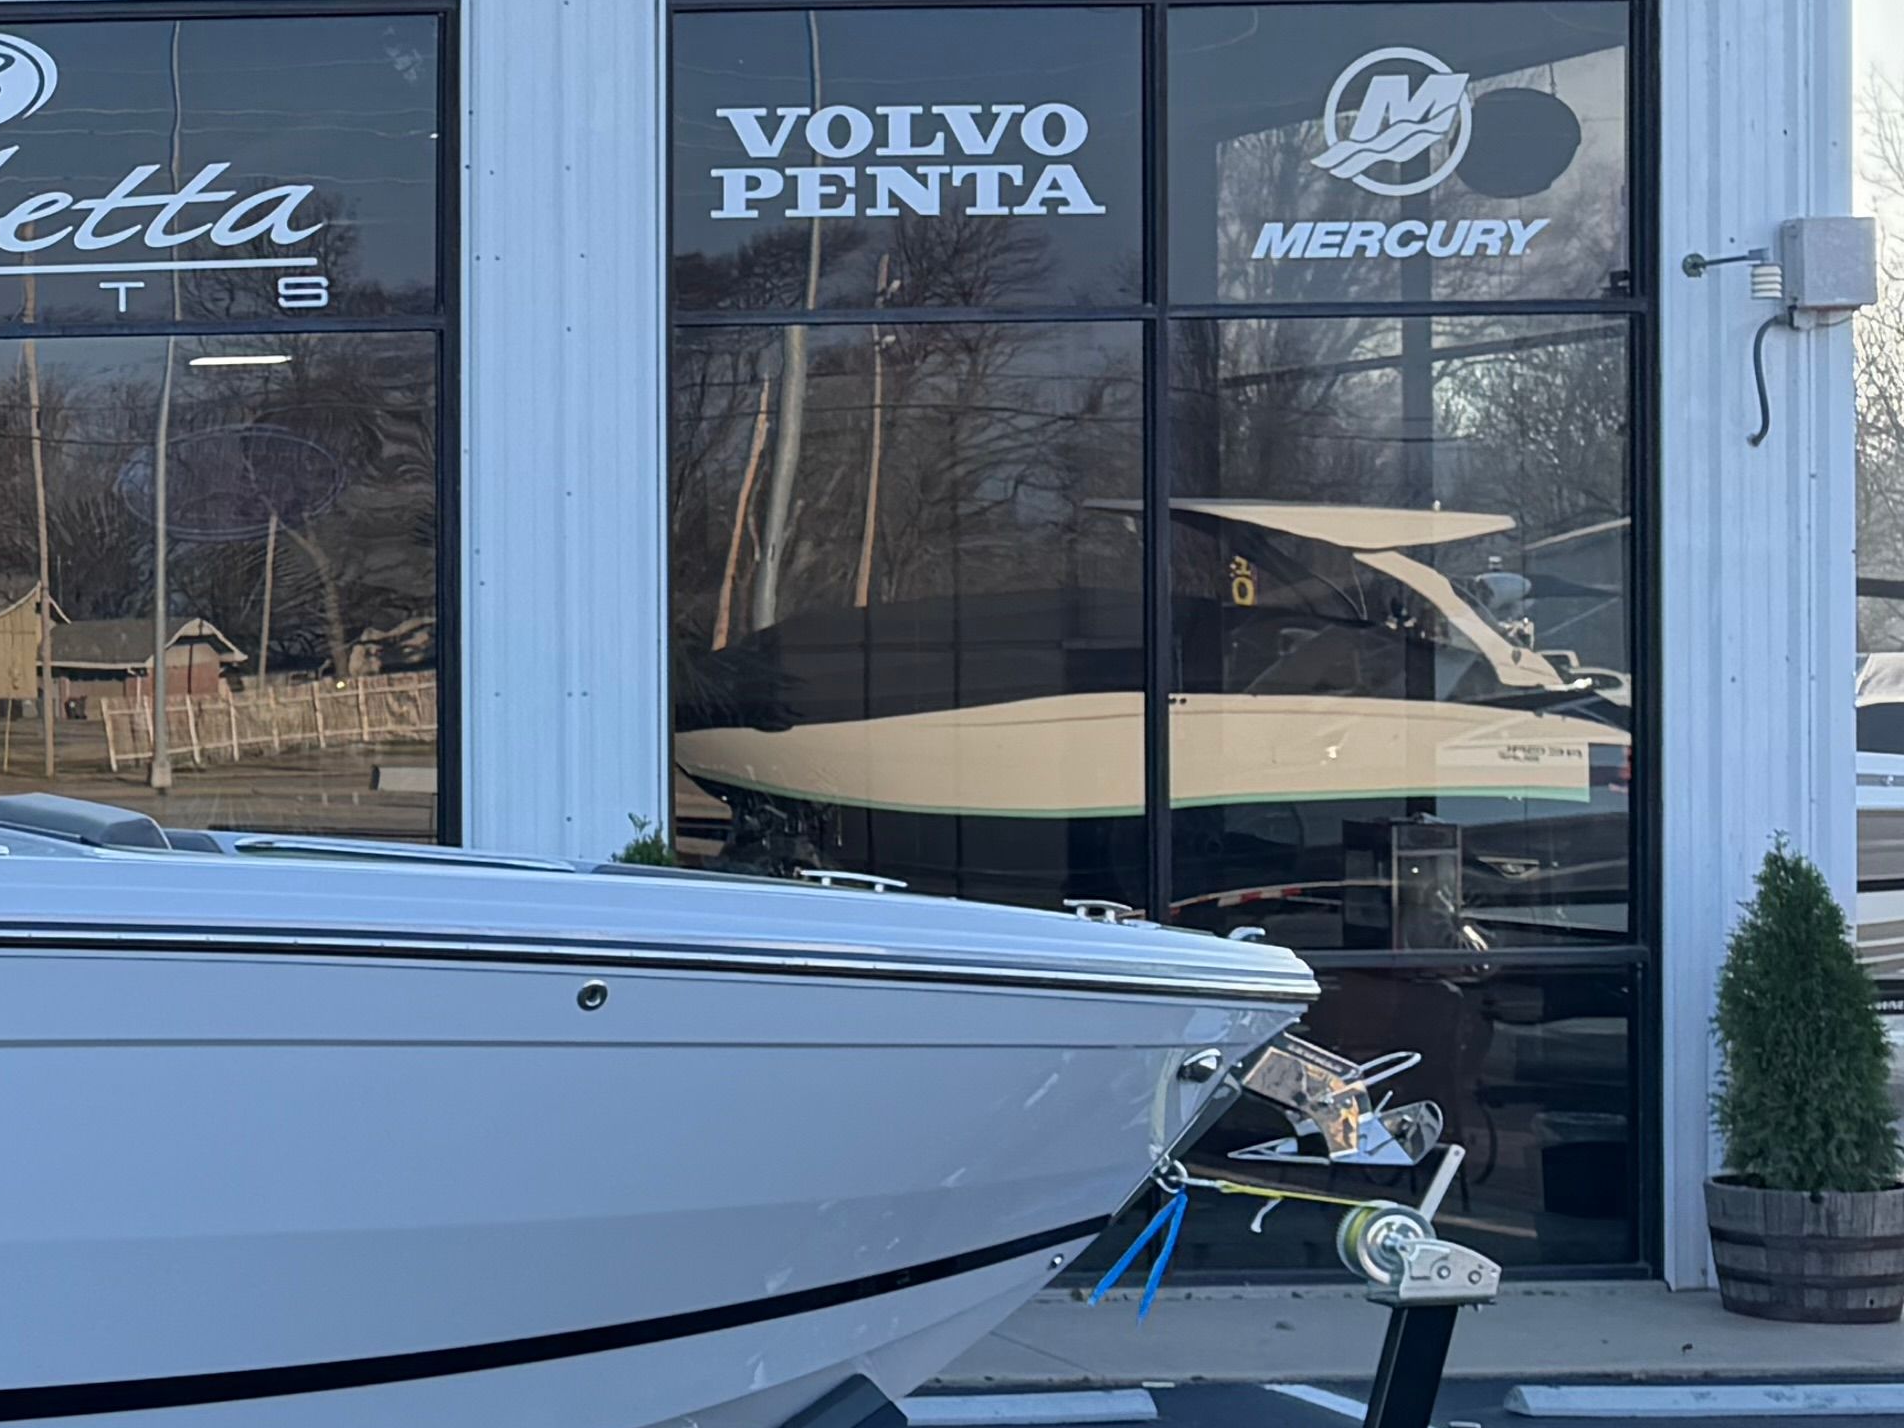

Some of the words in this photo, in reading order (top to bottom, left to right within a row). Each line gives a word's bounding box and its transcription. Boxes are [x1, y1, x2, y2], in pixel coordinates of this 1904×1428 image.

[715, 102, 1089, 160] VOLVO
[710, 164, 1107, 219] PENTA
[1250, 218, 1550, 261] MERCURY
